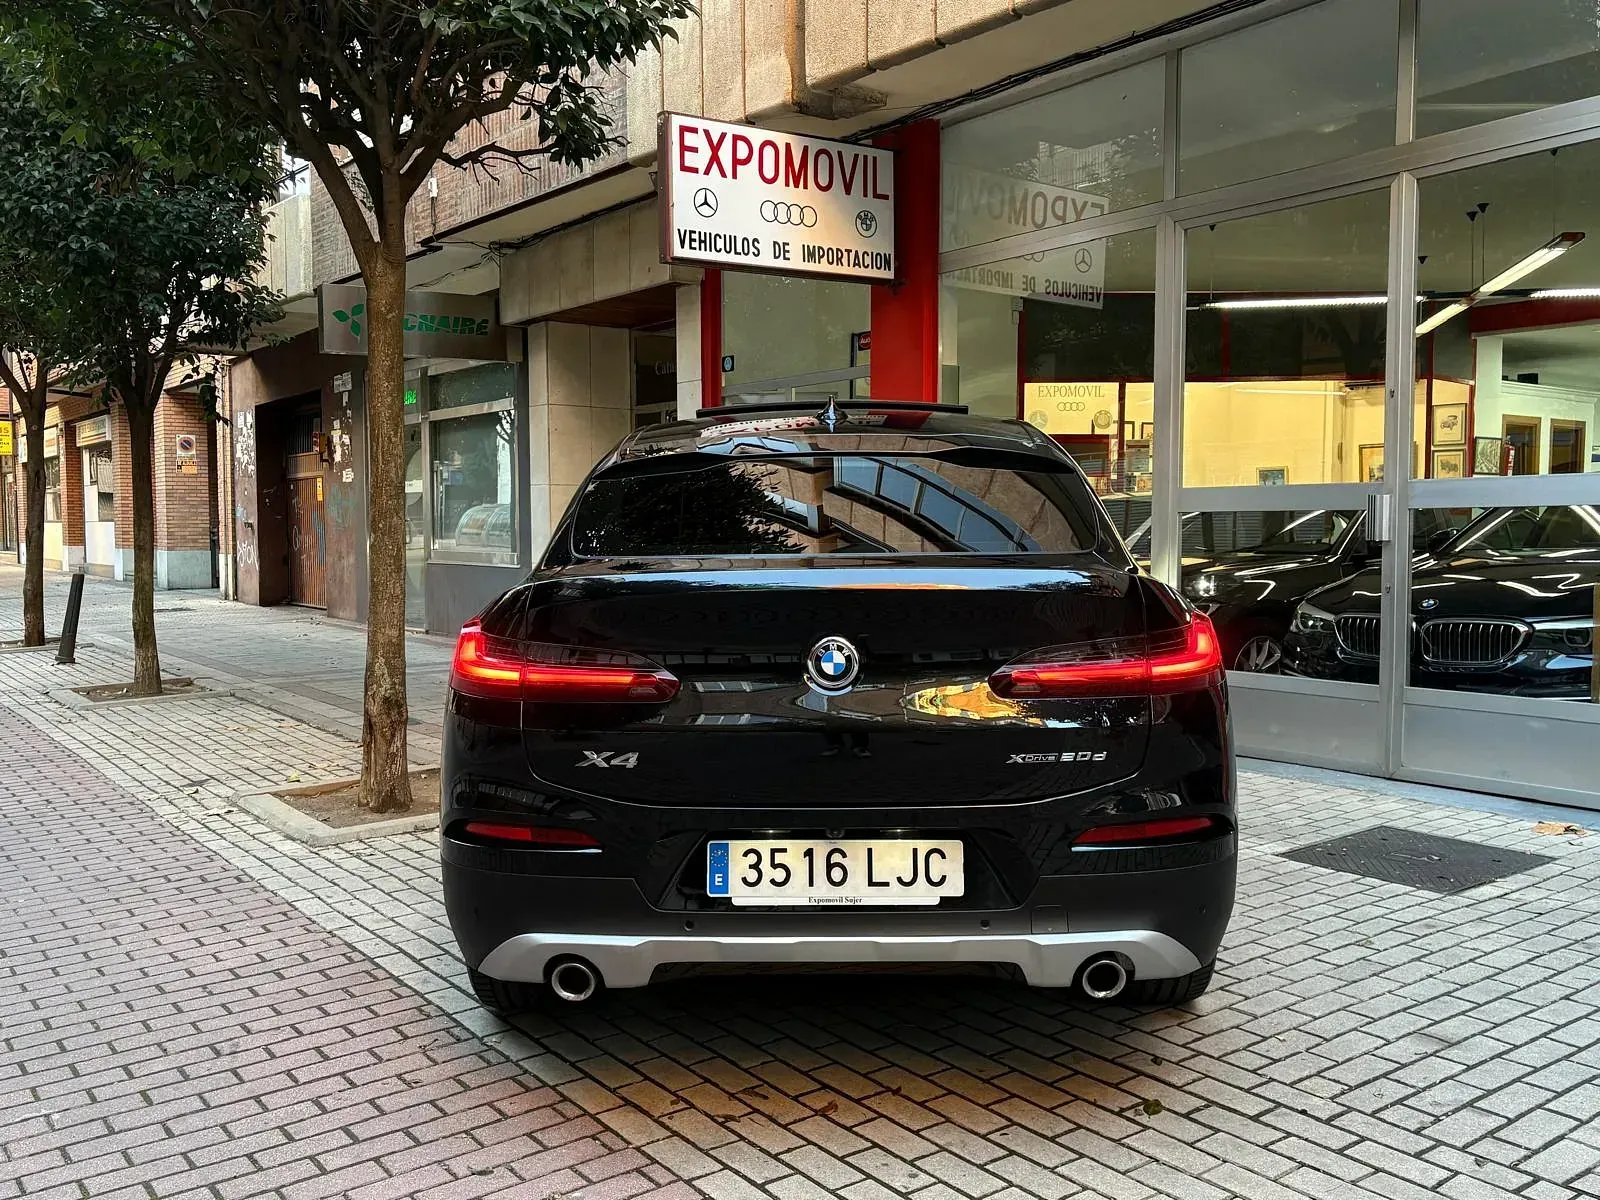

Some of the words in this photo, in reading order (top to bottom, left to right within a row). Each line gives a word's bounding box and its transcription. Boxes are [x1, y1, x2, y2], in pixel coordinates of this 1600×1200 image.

[678, 124, 890, 201] EXPOMOVIL
[677, 228, 761, 258] VEHICULOS
[773, 240, 791, 261] DE
[802, 243, 892, 272] IMPORTACION
[1038, 385, 1105, 398] EXPOMOVIL
[818, 643, 851, 656] BMW
[575, 750, 639, 769] X4
[1060, 751, 1108, 762] 20d
[714, 873, 724, 886] E
[740, 847, 849, 888] 3516
[867, 847, 948, 888] LJC
[808, 896, 843, 905] Expomovil
